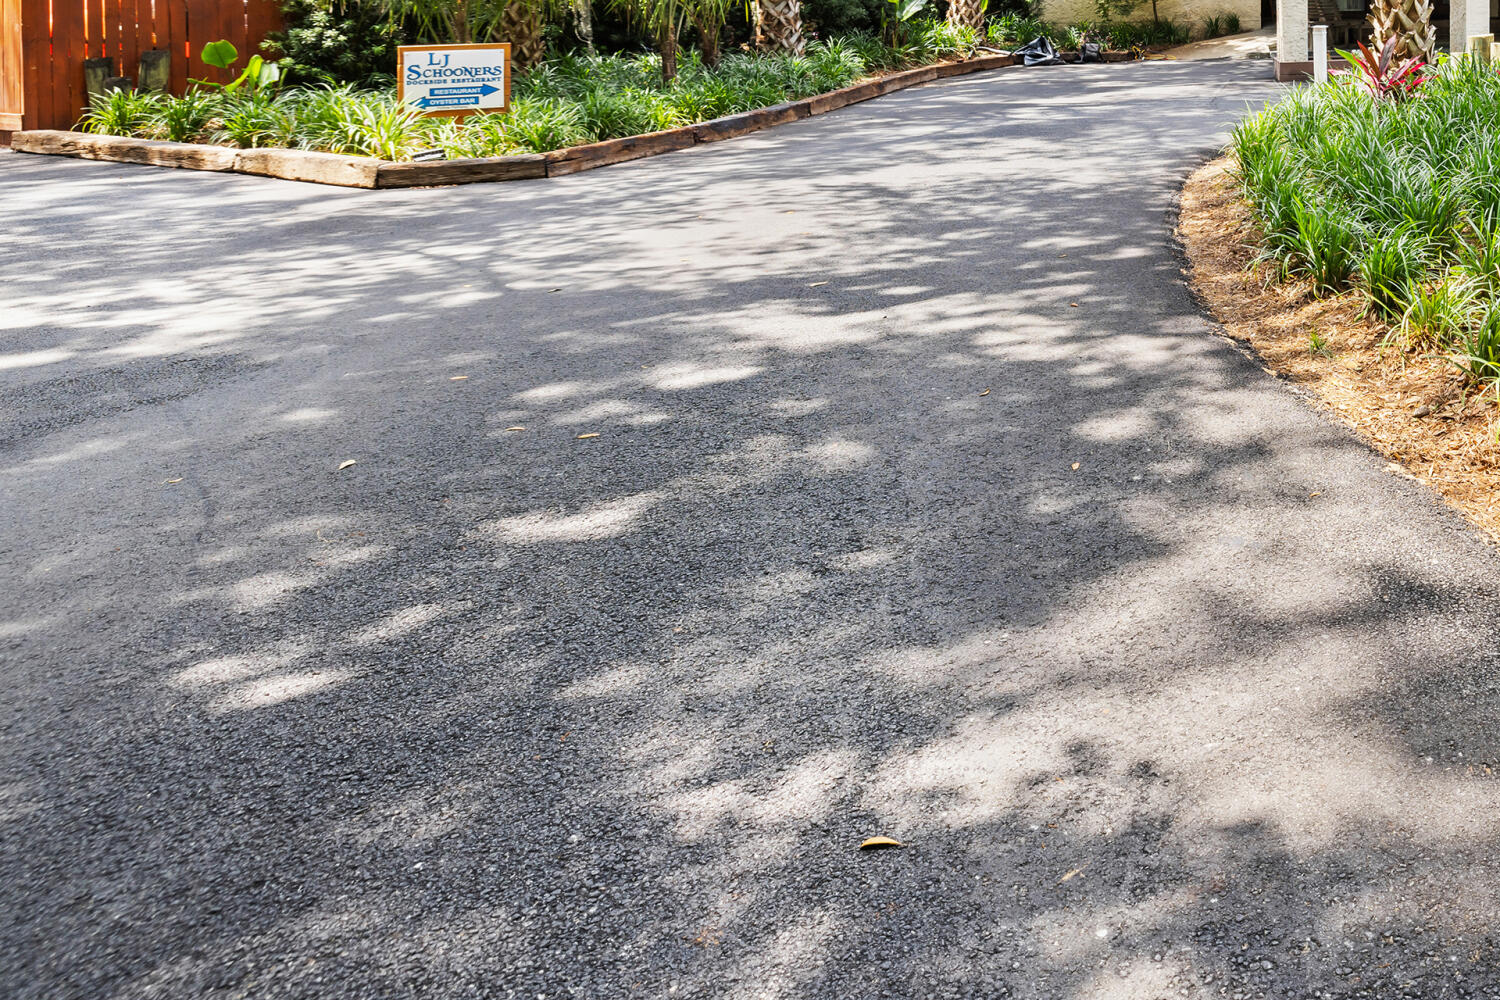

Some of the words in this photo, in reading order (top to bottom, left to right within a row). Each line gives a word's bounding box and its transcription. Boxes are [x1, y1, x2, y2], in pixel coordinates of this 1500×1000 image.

[427, 52, 450, 68] LJ
[433, 87, 482, 95] RESTAURANT
[429, 98, 459, 106] OYSTER
[460, 97, 476, 105] BAR
